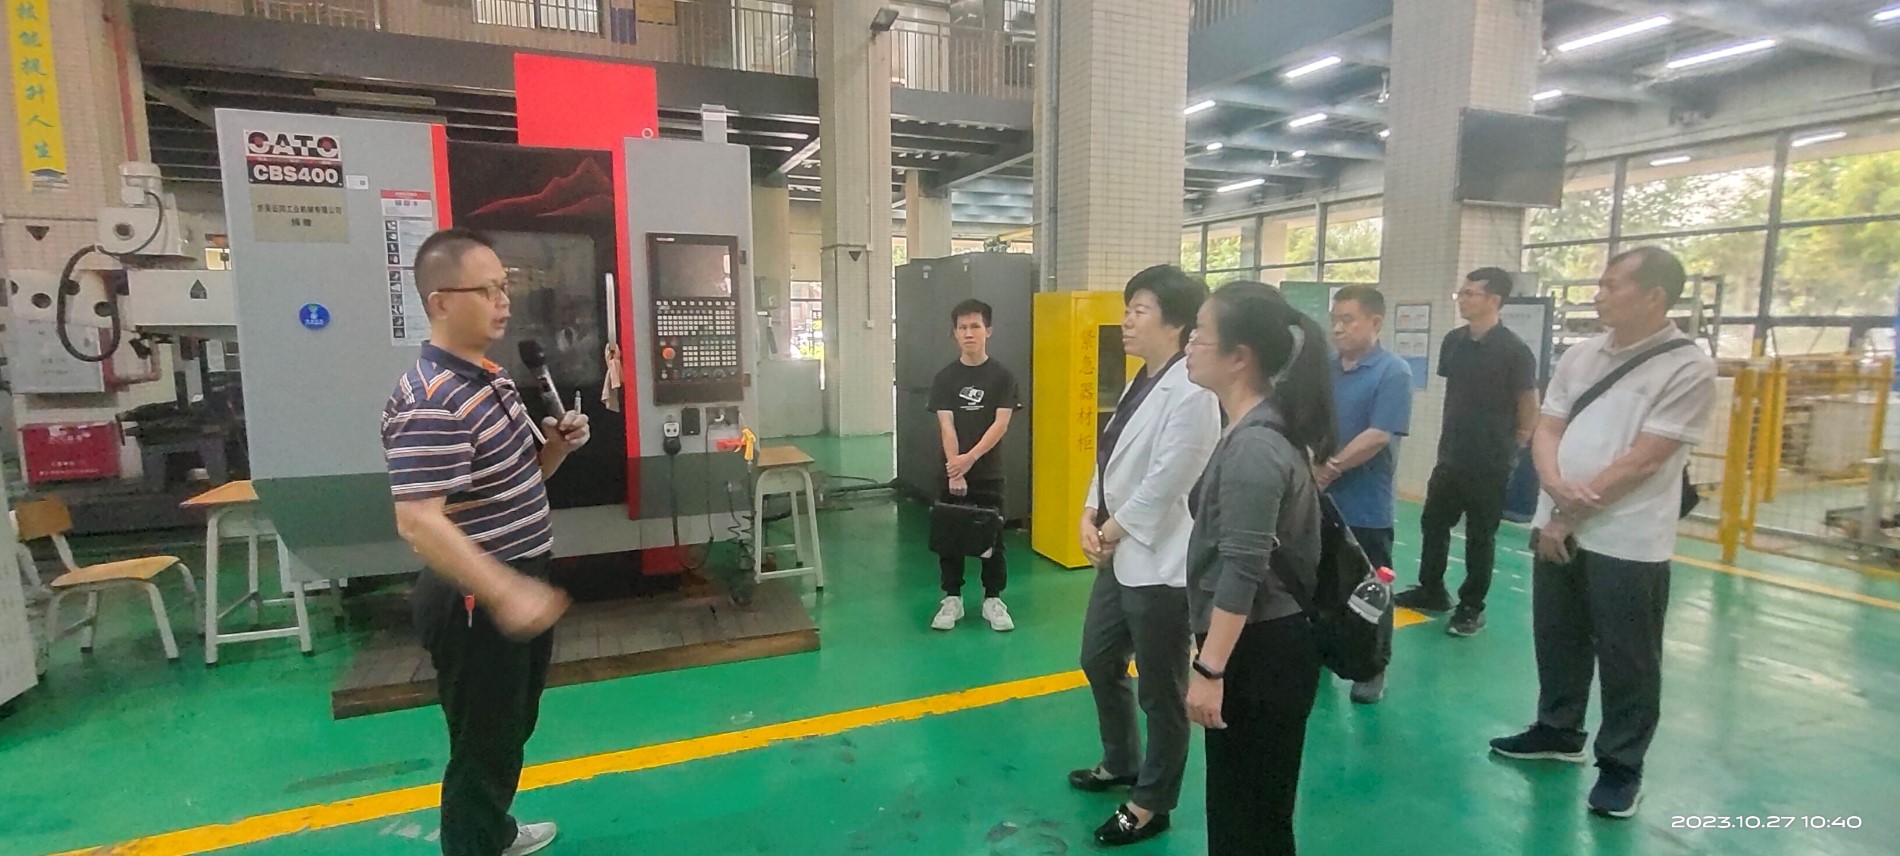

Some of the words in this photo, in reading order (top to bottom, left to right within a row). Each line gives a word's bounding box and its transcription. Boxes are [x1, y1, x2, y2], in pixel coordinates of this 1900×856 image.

[253, 164, 339, 184] CBS400
[1077, 329, 1096, 452] 紧急器材柜
